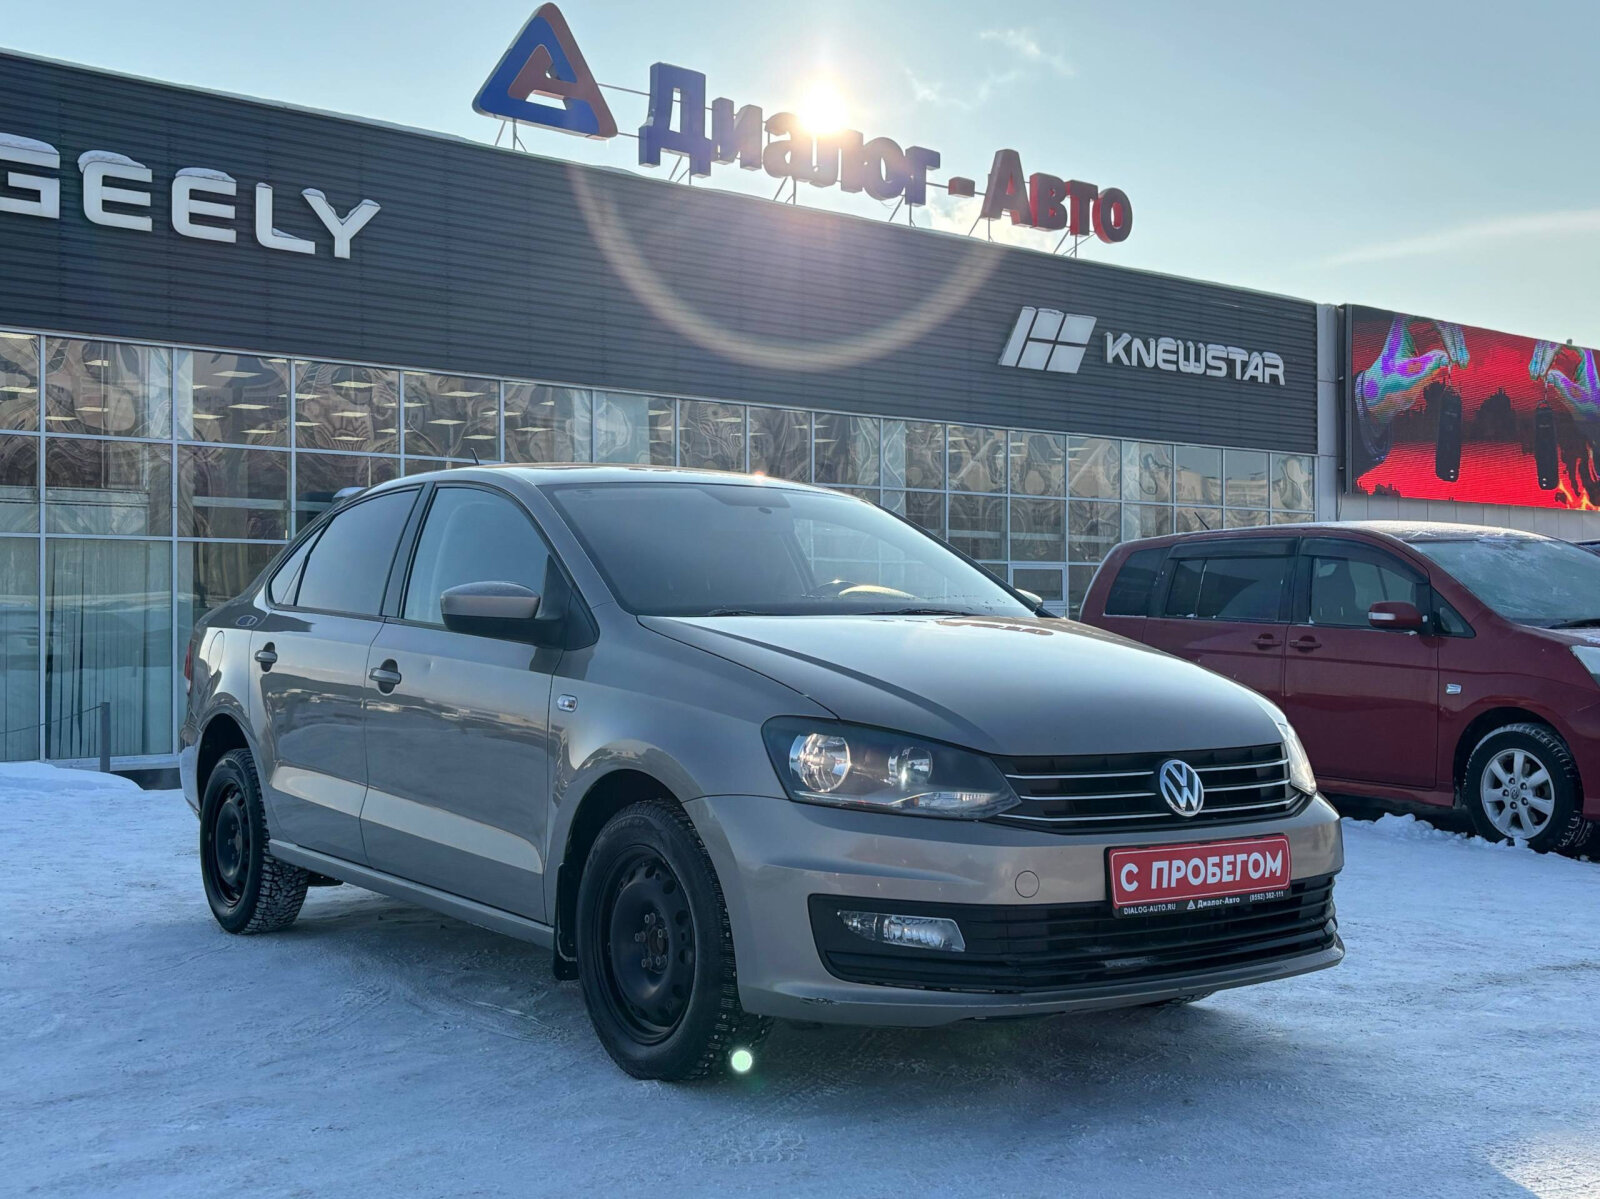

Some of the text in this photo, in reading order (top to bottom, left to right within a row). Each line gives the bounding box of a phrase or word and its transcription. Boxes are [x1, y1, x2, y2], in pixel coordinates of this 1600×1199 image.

[0, 139, 381, 259] GEELY
[1104, 332, 1285, 386] KNEWSTAR
[1120, 849, 1283, 892] С ПРОБЕГОМ
[1123, 902, 1176, 915] DIALOG-AUTO.RU
[1197, 896, 1241, 909] Диалог-Авто
